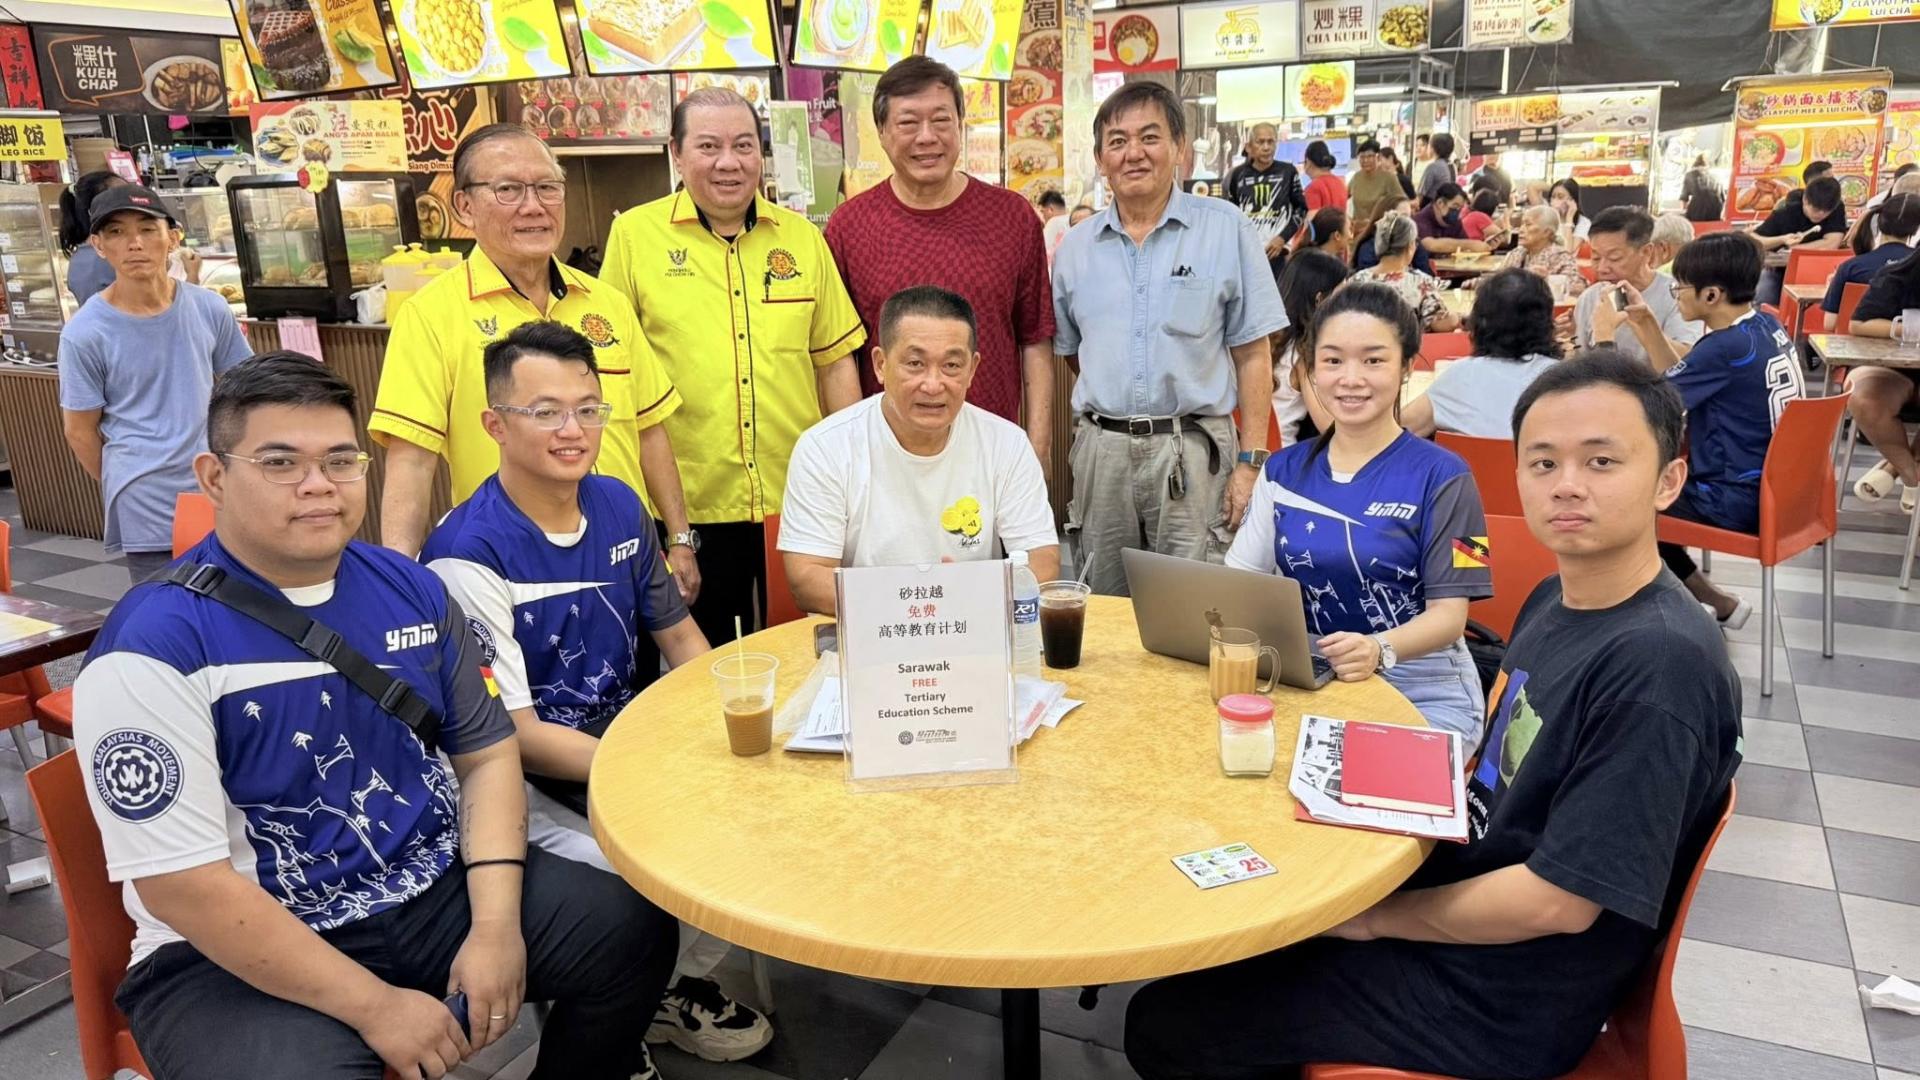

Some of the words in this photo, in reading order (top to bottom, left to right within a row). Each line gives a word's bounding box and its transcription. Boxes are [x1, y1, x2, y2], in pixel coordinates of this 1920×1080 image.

[1306, 33, 1330, 44] CHA
[1334, 30, 1368, 42] KUEH
[76, 67, 117, 79] KUEH
[78, 78, 118, 90] CHAP
[813, 98, 836, 109] Fruit
[2, 149, 20, 157] LEG
[23, 148, 45, 156] RICE
[899, 585, 944, 600] 砂拉越
[907, 604, 937, 618] 免费
[878, 620, 967, 638] 高等教育计划
[898, 660, 951, 673] Sarawak
[912, 678, 938, 687] FREE
[904, 691, 946, 703] Tertiary
[878, 707, 930, 719] Education
[932, 705, 973, 715] Scheme
[95, 733, 144, 765] MALAYSIAS
[146, 738, 179, 798] MOVEMENT
[94, 768, 114, 807] YOUNG
[1239, 857, 1268, 872] 25
